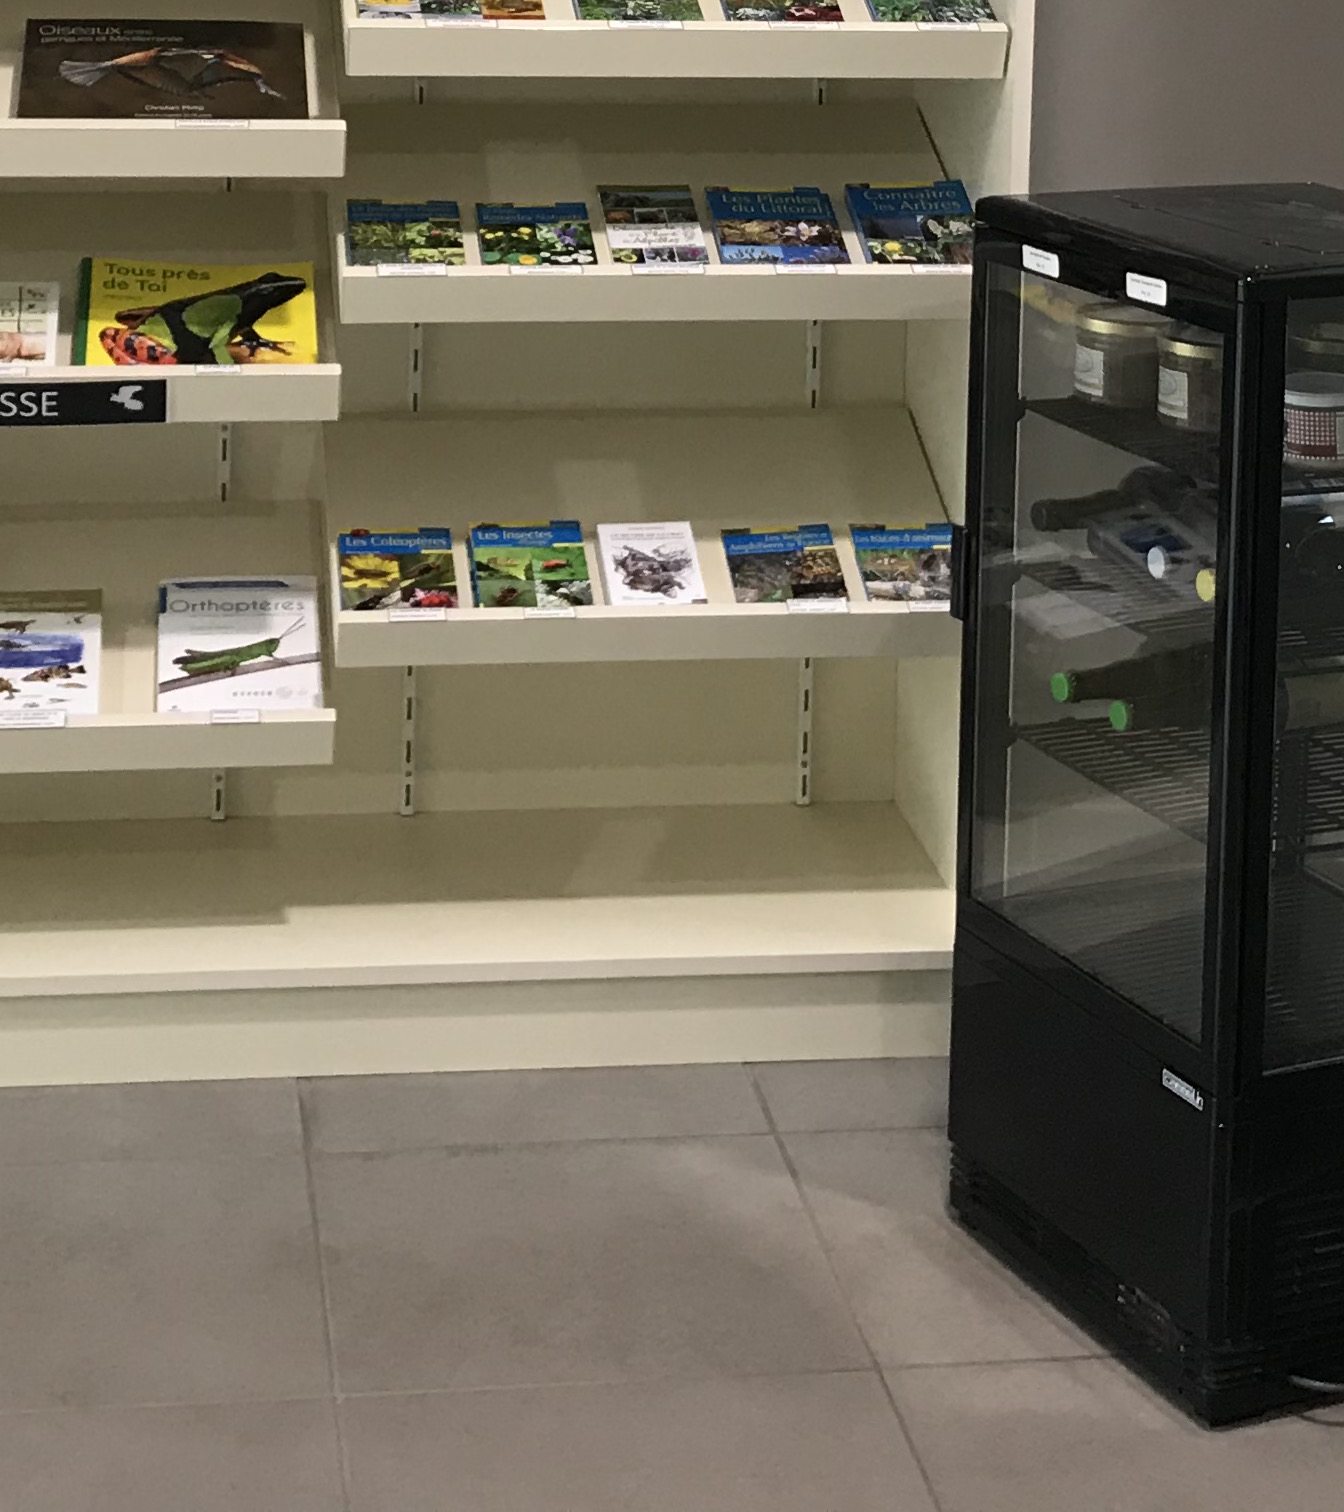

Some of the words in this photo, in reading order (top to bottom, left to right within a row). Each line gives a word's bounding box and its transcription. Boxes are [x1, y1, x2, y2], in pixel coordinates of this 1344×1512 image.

[39, 25, 120, 35] Oiseaux
[761, 204, 822, 214] Littoral
[873, 202, 896, 211] les
[900, 200, 961, 211] Arbres
[103, 263, 154, 277] Tous
[161, 264, 211, 281] près
[102, 279, 132, 291] de
[477, 529, 499, 539] Les
[502, 528, 553, 539] Insectes
[345, 536, 367, 546] Les
[371, 535, 447, 548] Coléoptères
[170, 599, 304, 613] Orthoptères
